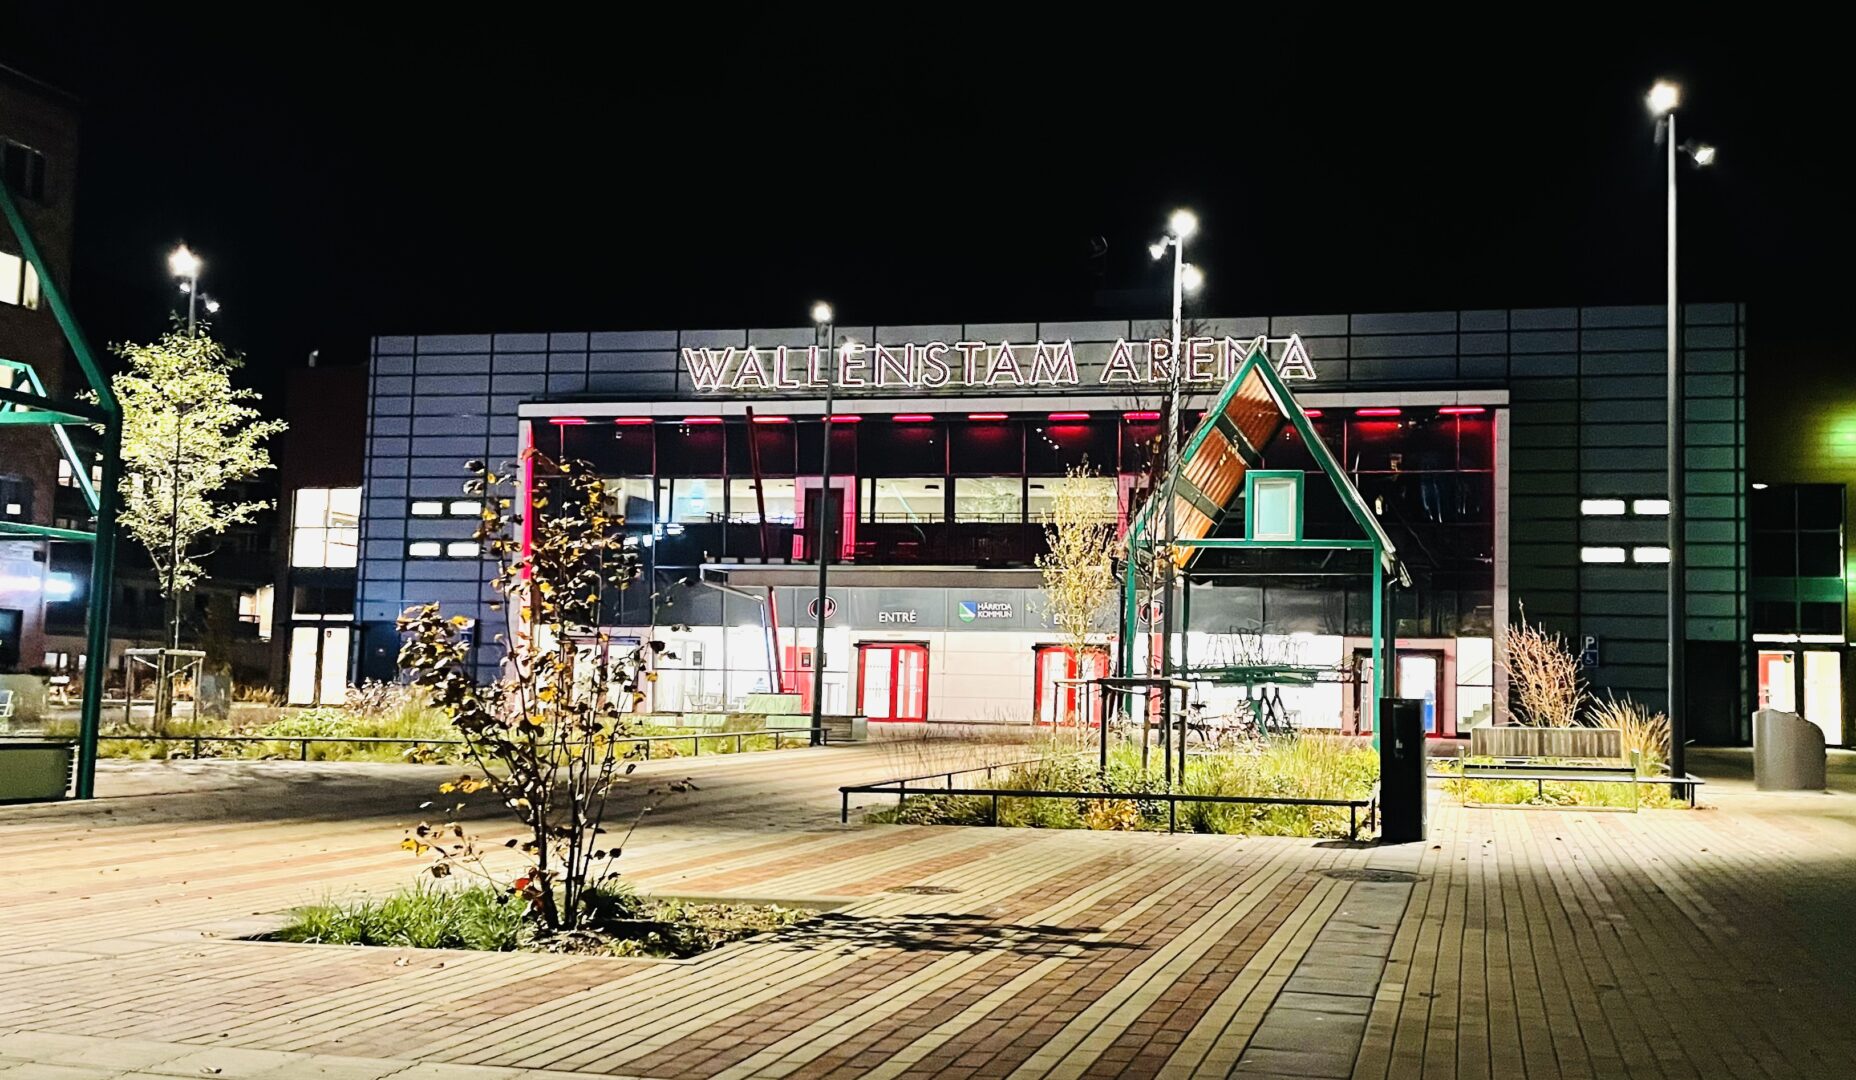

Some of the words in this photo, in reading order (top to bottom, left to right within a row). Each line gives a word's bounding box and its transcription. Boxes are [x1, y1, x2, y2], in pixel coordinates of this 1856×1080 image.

[682, 338, 1079, 392] WALLENSTAM
[878, 609, 917, 624] ENTRÉ
[977, 610, 1013, 618] KOMMUN
[1585, 636, 1595, 649] P
